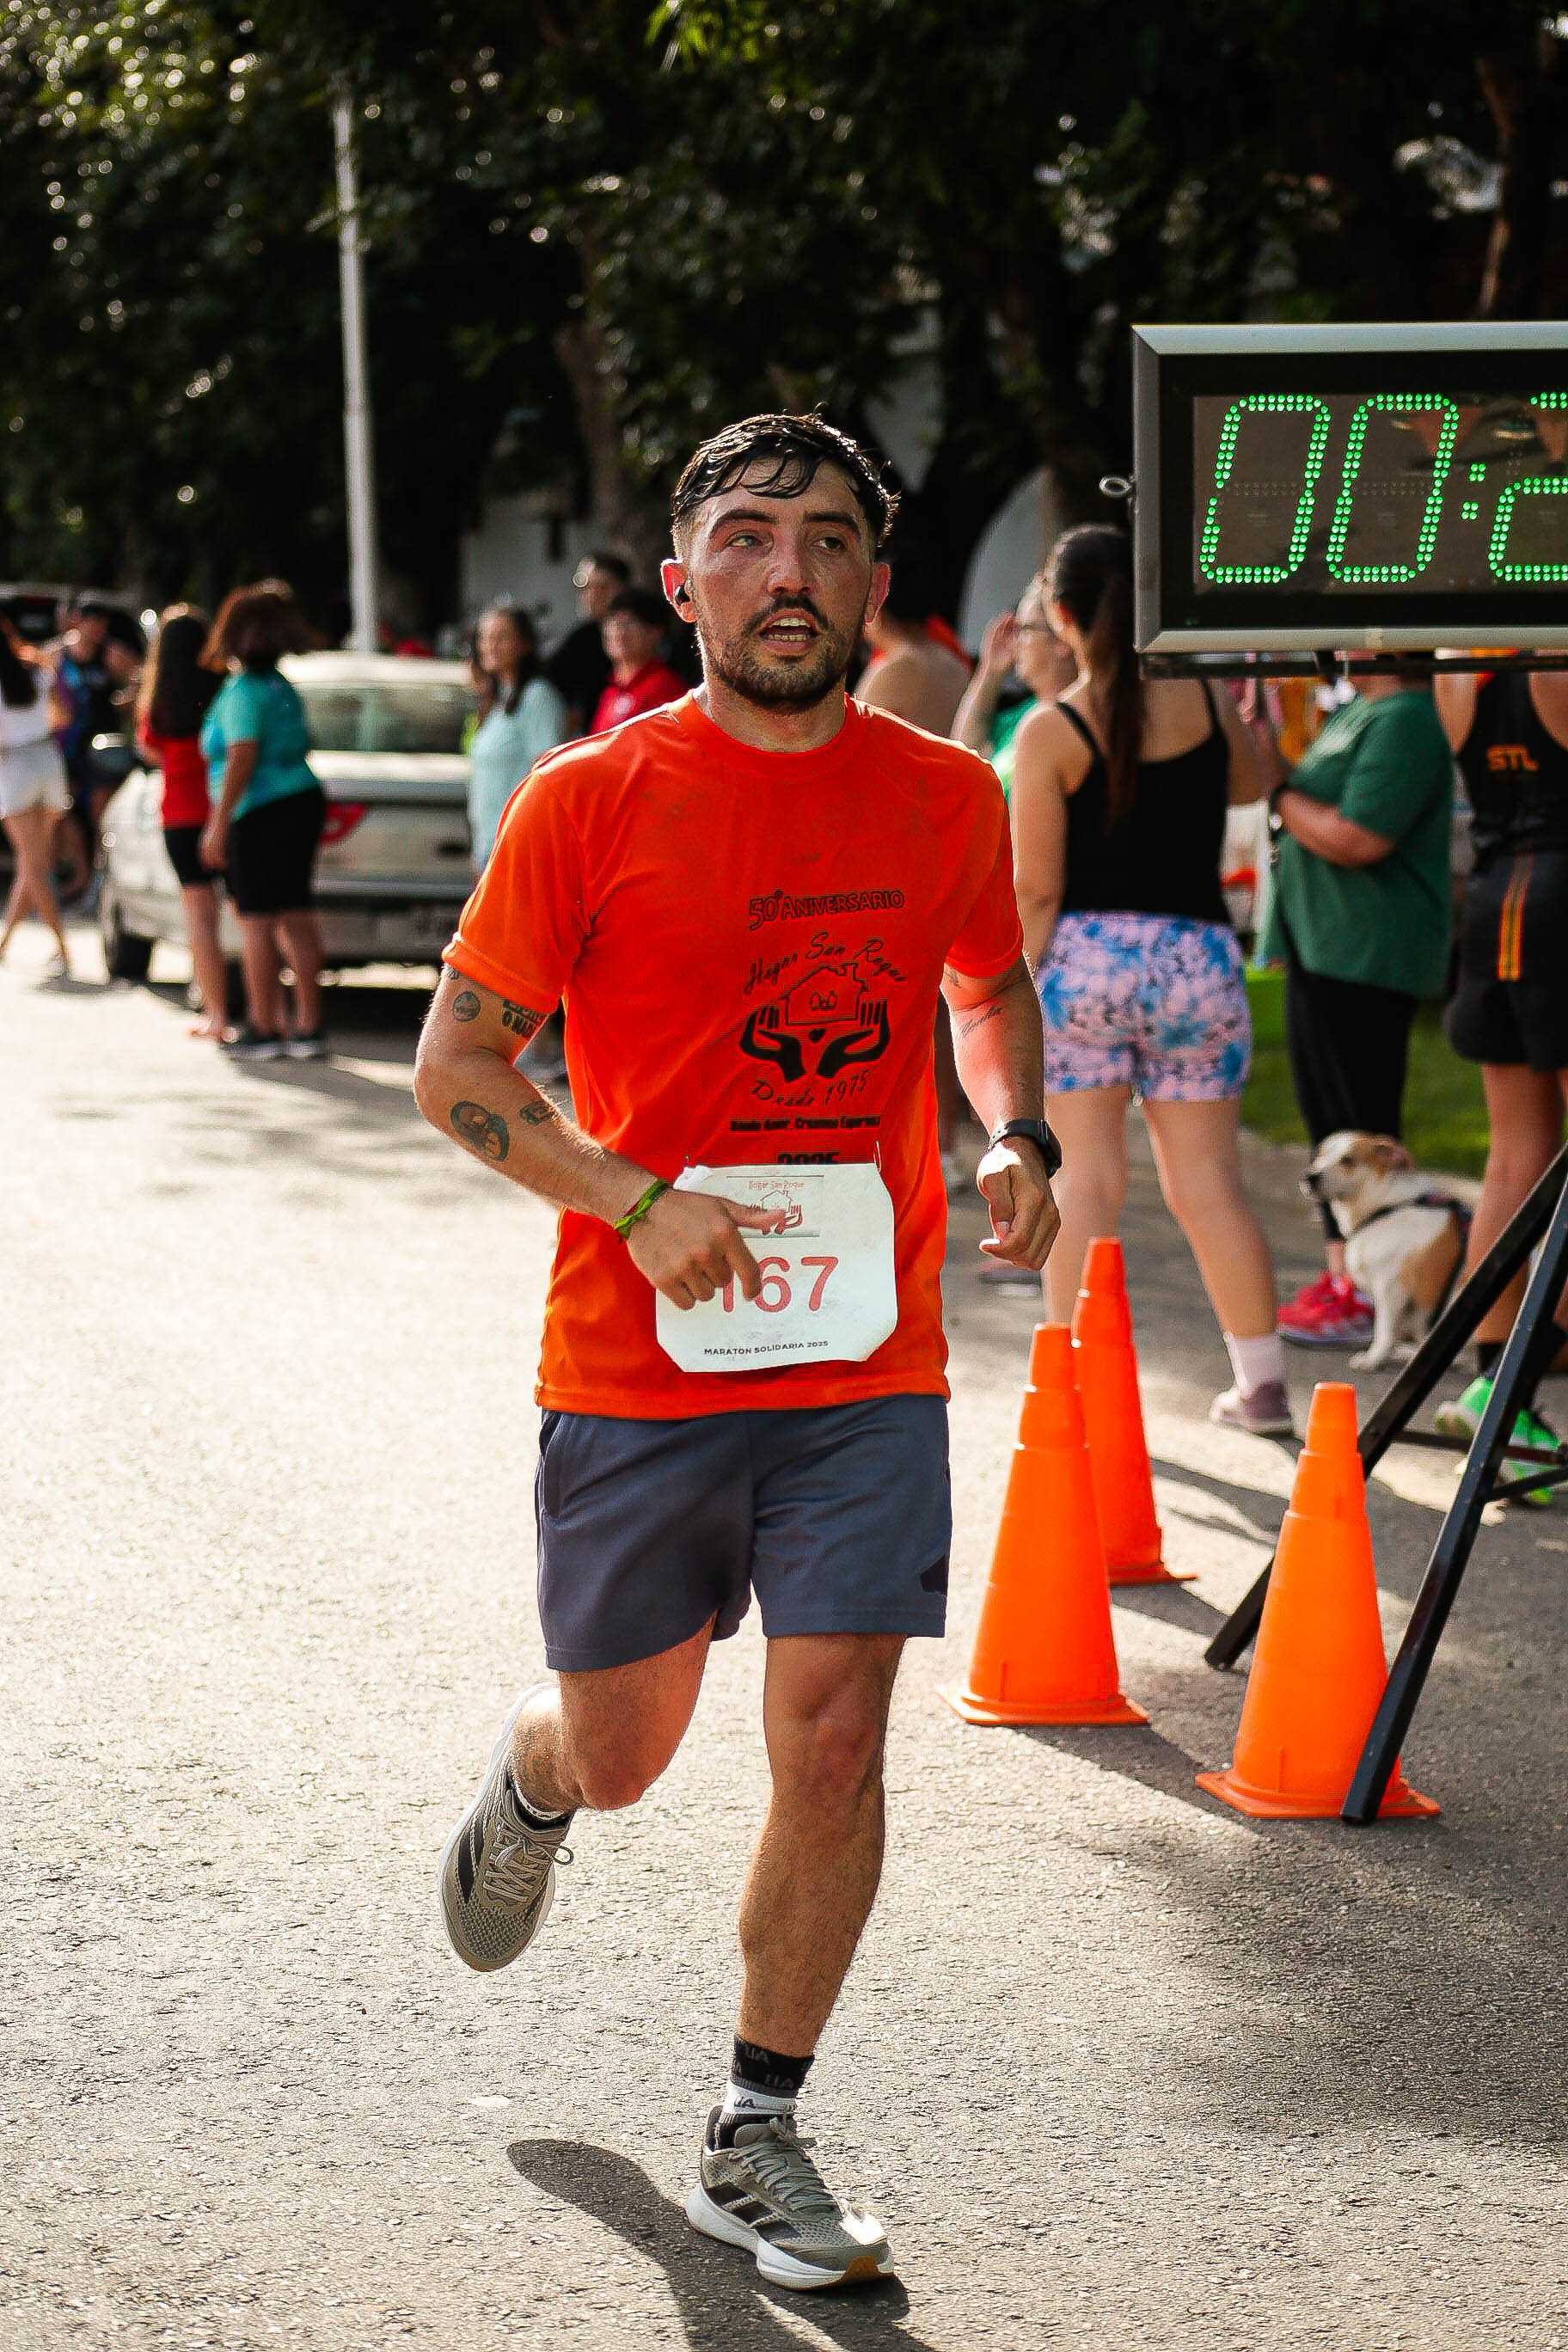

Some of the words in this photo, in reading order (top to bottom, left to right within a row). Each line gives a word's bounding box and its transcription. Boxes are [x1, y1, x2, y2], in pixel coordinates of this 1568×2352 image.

[781, 890, 905, 922] ANIVERSARIO
[722, 1256, 839, 1314] 167
[754, 1342, 805, 1354] SOLIDARIA
